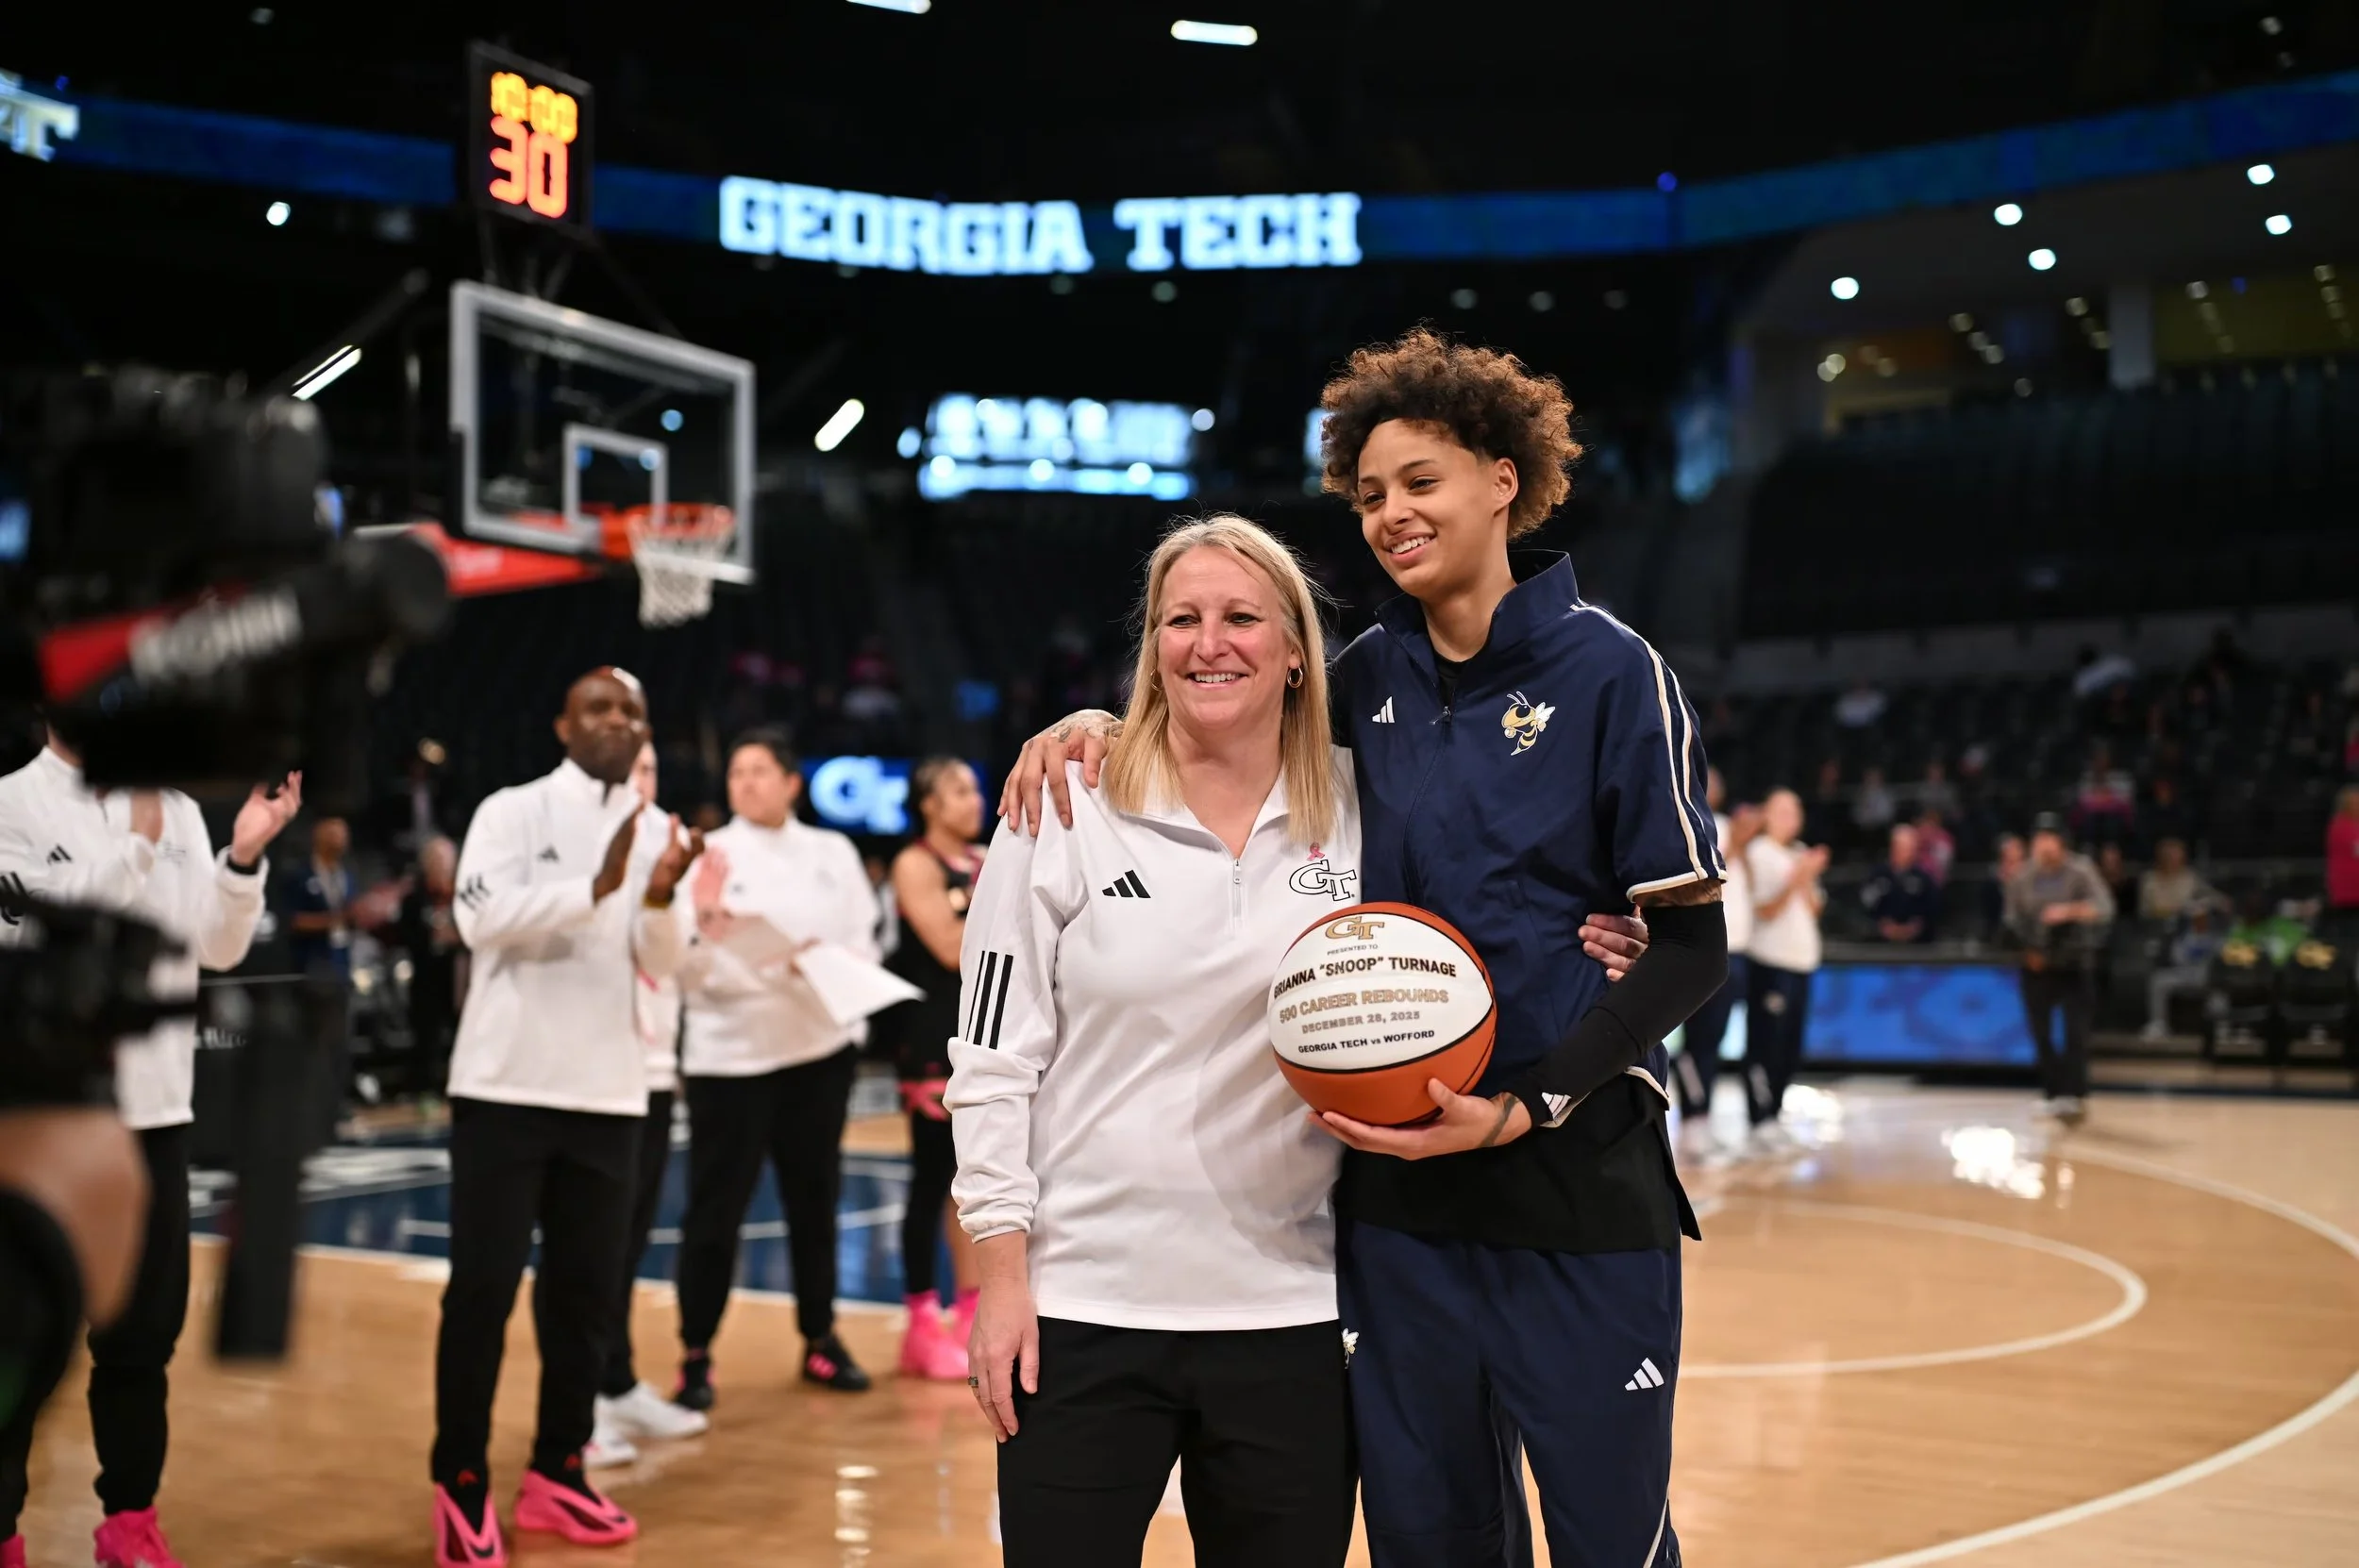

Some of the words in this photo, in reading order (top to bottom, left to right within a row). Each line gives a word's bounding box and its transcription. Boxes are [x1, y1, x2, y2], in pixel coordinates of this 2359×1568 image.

[489, 115, 568, 219] 30
[719, 175, 1094, 275] GEORGIA
[1113, 192, 1363, 272] TECH
[1289, 859, 1357, 901] GT
[1325, 916, 1385, 940] GT
[1327, 944, 1366, 956] PRESENTED
[1274, 968, 1316, 999] BRIANNA
[1388, 957, 1457, 977] TURNAGE
[1280, 1005, 1297, 1024] 500
[1299, 992, 1358, 1015] CAREER
[1362, 989, 1449, 1005] REBOUNDS
[1301, 1015, 1364, 1034] DECEMBER
[1366, 1013, 1386, 1024] 28,
[1390, 1010, 1420, 1022] 2025
[1298, 1043, 1338, 1054] GEORGIA
[1340, 1038, 1368, 1048] TECH
[1383, 1030, 1435, 1043] WOFFORD
